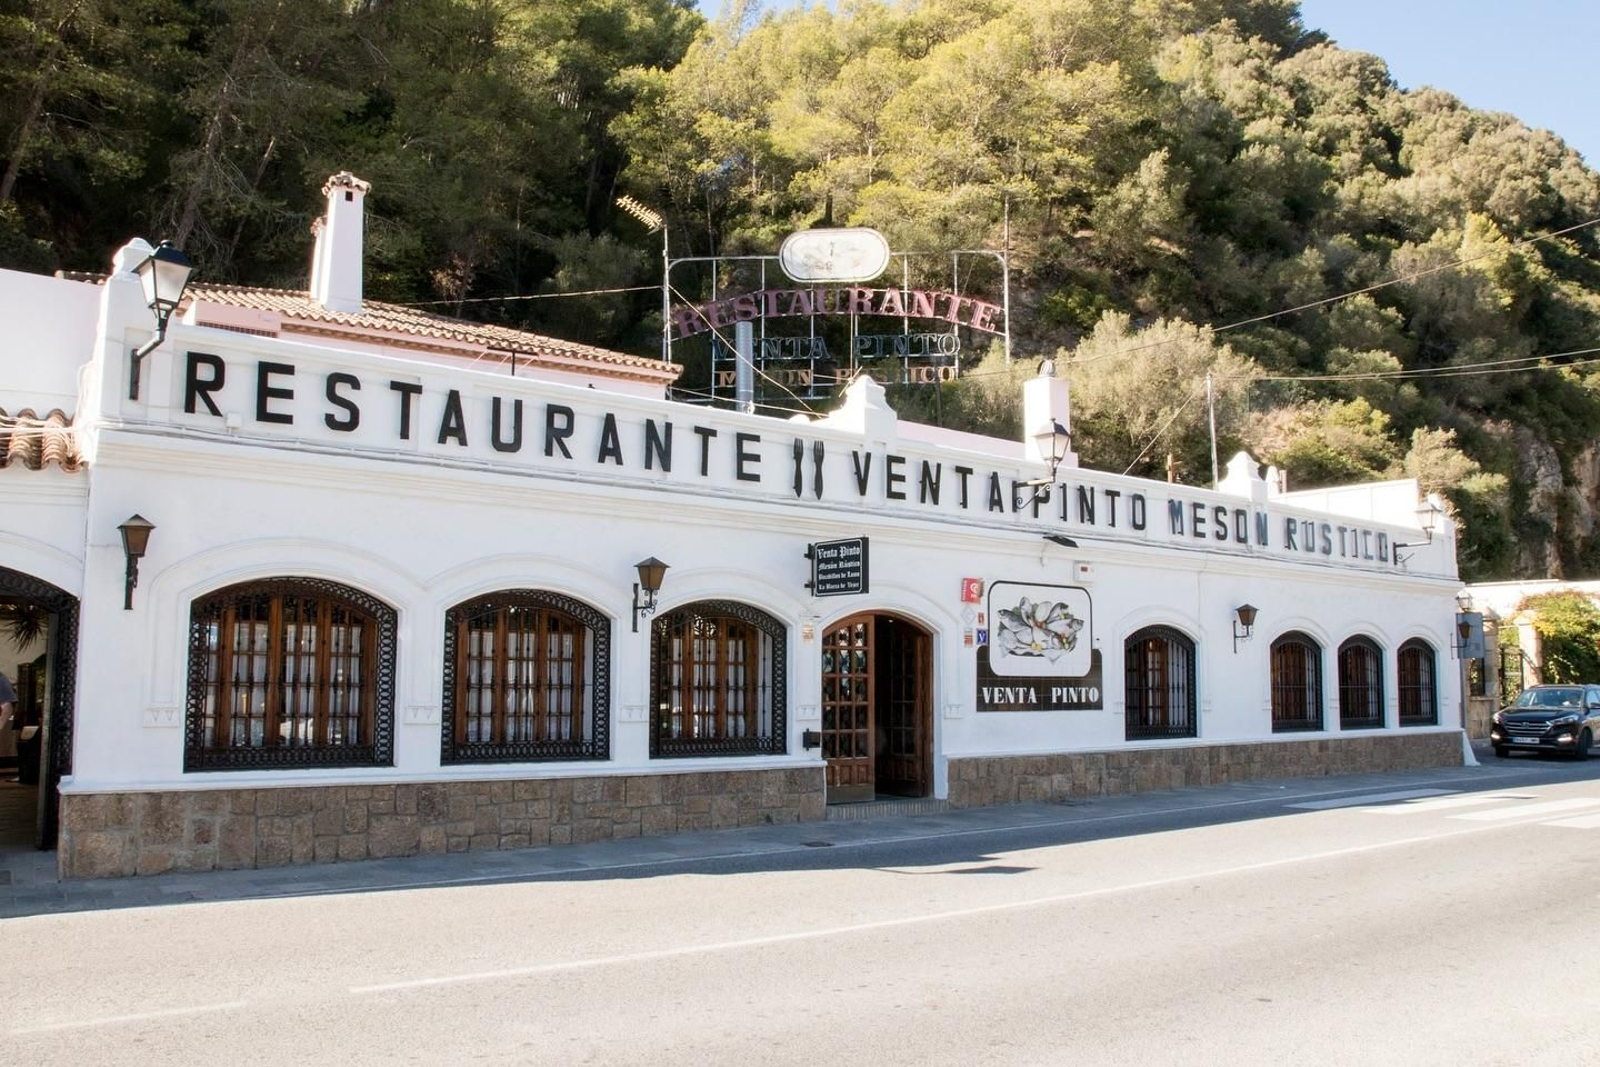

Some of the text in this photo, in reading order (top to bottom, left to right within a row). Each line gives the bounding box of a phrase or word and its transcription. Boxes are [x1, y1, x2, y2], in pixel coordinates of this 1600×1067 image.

[671, 286, 1001, 338] RESTAURANTE
[853, 332, 961, 358] PINTO
[184, 351, 1389, 562] RESTAURANTE VENTA PINTO MESON RUSTICO
[982, 686, 1100, 704] VENTA PINTO
